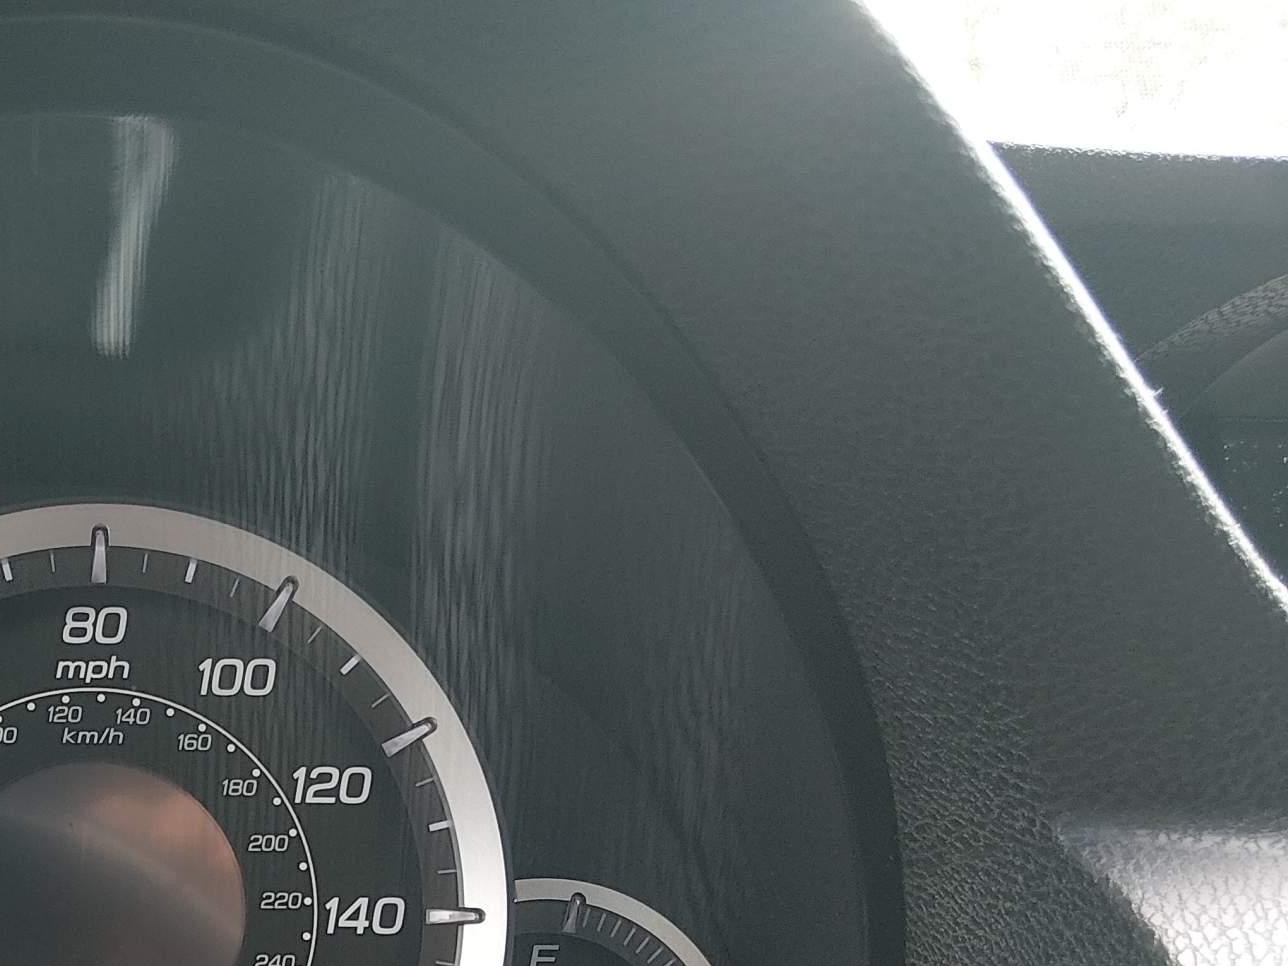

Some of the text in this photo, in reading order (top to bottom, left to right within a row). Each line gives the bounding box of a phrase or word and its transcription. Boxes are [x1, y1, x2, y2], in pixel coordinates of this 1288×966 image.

[62, 606, 128, 644] 80
[55, 656, 130, 683] mph
[198, 658, 277, 696] 100
[47, 706, 83, 723] 120
[116, 706, 150, 724] 140
[62, 728, 124, 744] km/h
[177, 733, 212, 751] 160
[222, 778, 258, 796] 180
[292, 766, 372, 804] 120
[247, 834, 289, 852] 200
[260, 892, 302, 909] 220
[325, 896, 406, 935] 140
